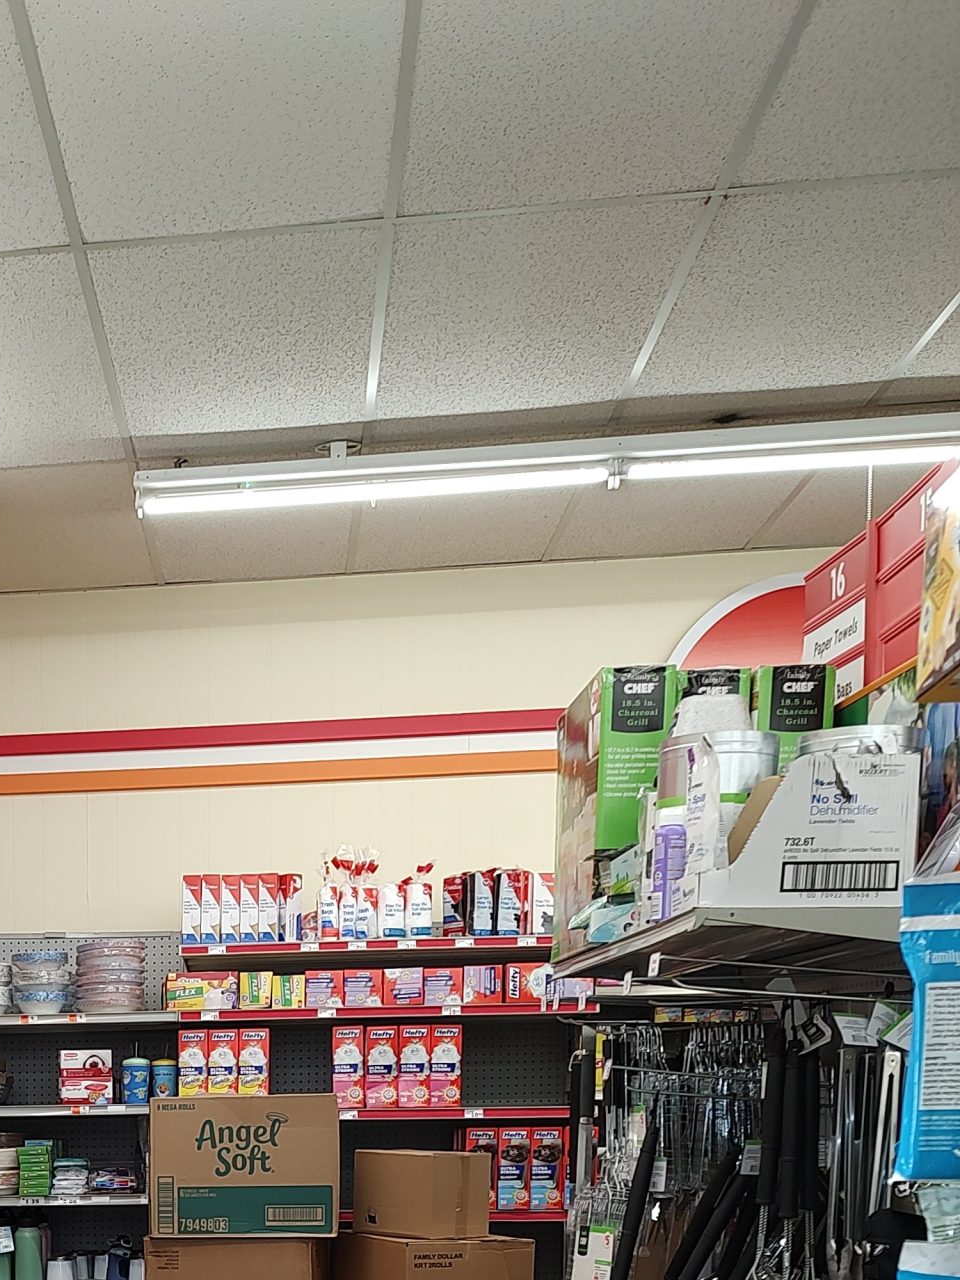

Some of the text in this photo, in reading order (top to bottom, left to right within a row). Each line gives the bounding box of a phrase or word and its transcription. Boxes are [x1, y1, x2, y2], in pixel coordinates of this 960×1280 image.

[830, 561, 846, 602] 16
[813, 616, 859, 658] Paper Towels
[623, 683, 656, 694] CHEF
[783, 681, 817, 693] CHEF
[836, 681, 853, 700] Bags
[618, 708, 659, 717] Charcoal
[776, 708, 818, 716] Charcoal
[627, 718, 649, 727] Grill
[785, 715, 809, 726] Grill
[812, 794, 829, 804] No
[810, 805, 879, 816] Dehumidifier
[784, 837, 816, 846] 732.6T
[511, 969, 520, 997] Hefty
[175, 989, 197, 997] FLEX
[195, 1119, 283, 1151] Angel
[215, 1145, 272, 1177] Soft
[180, 1217, 229, 1232] 7949803
